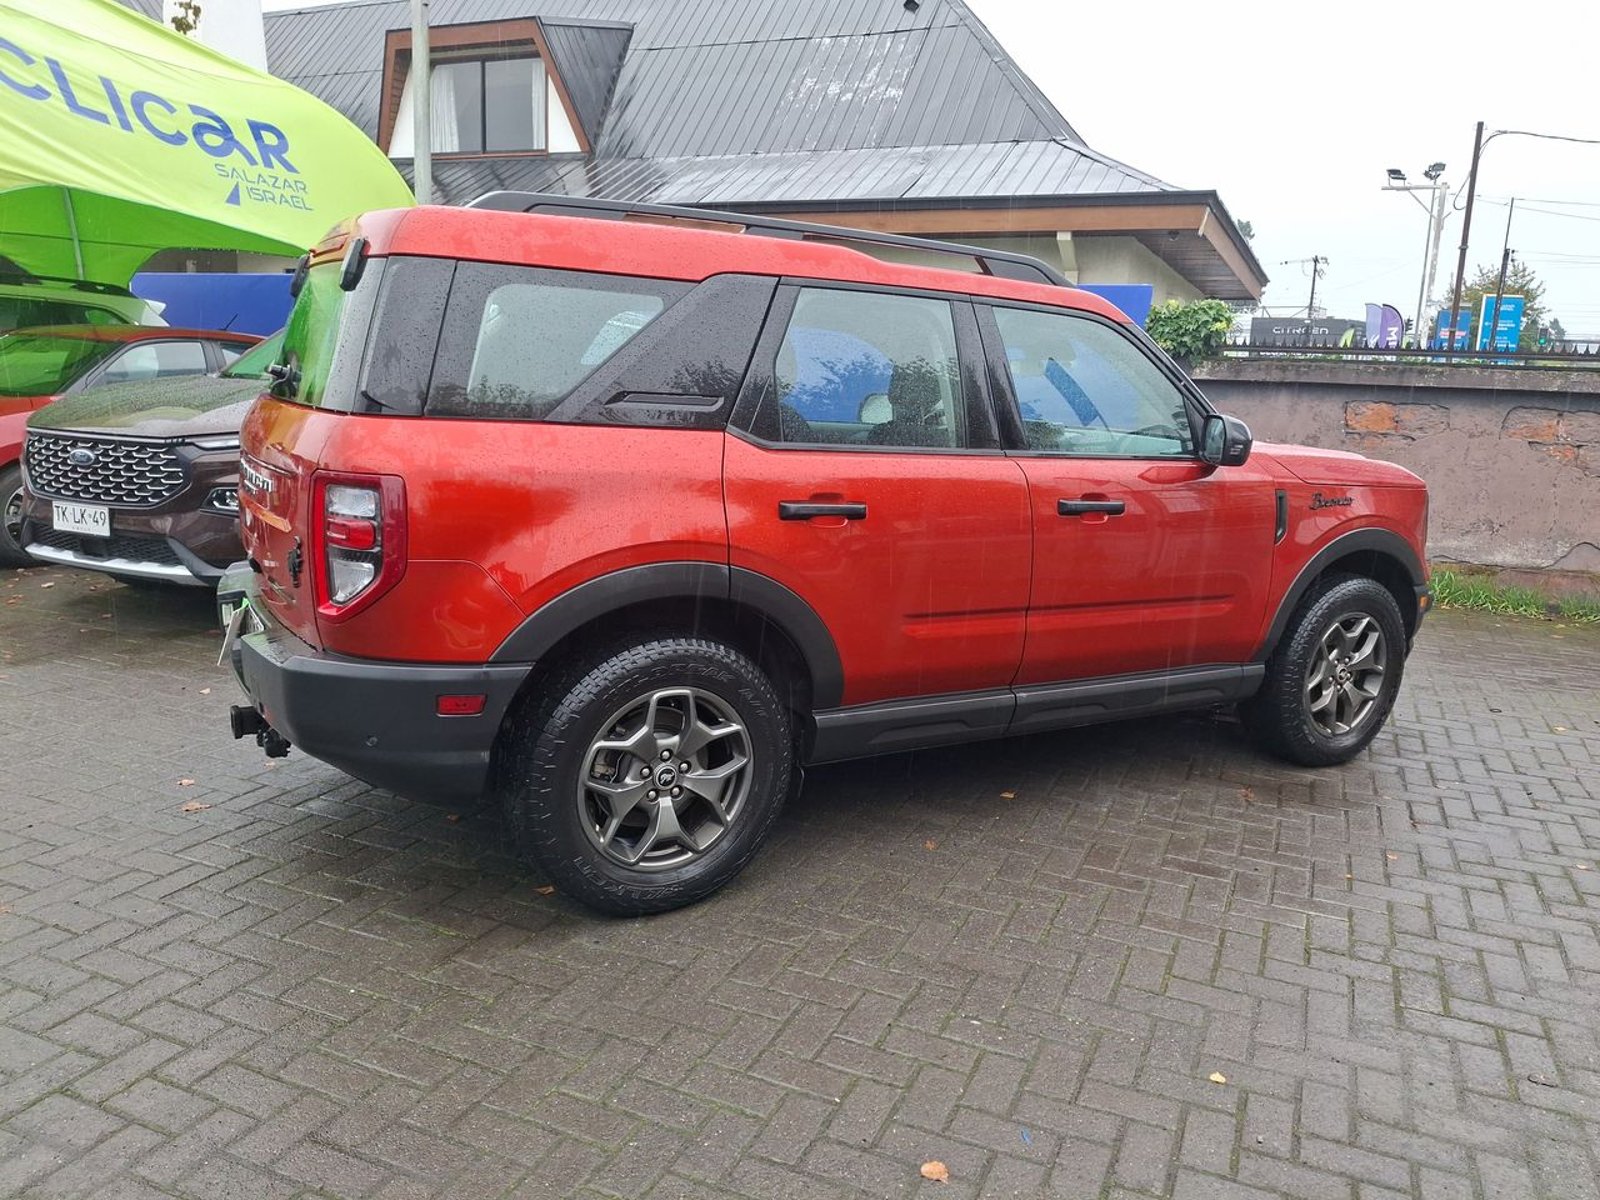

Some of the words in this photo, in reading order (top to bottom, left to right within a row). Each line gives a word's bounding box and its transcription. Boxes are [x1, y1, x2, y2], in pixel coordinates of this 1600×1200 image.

[214, 163, 308, 194] SALAZAR
[246, 186, 315, 211] ISRAEL
[54, 505, 69, 523] TK
[72, 507, 88, 525] LK
[92, 509, 107, 527] 49
